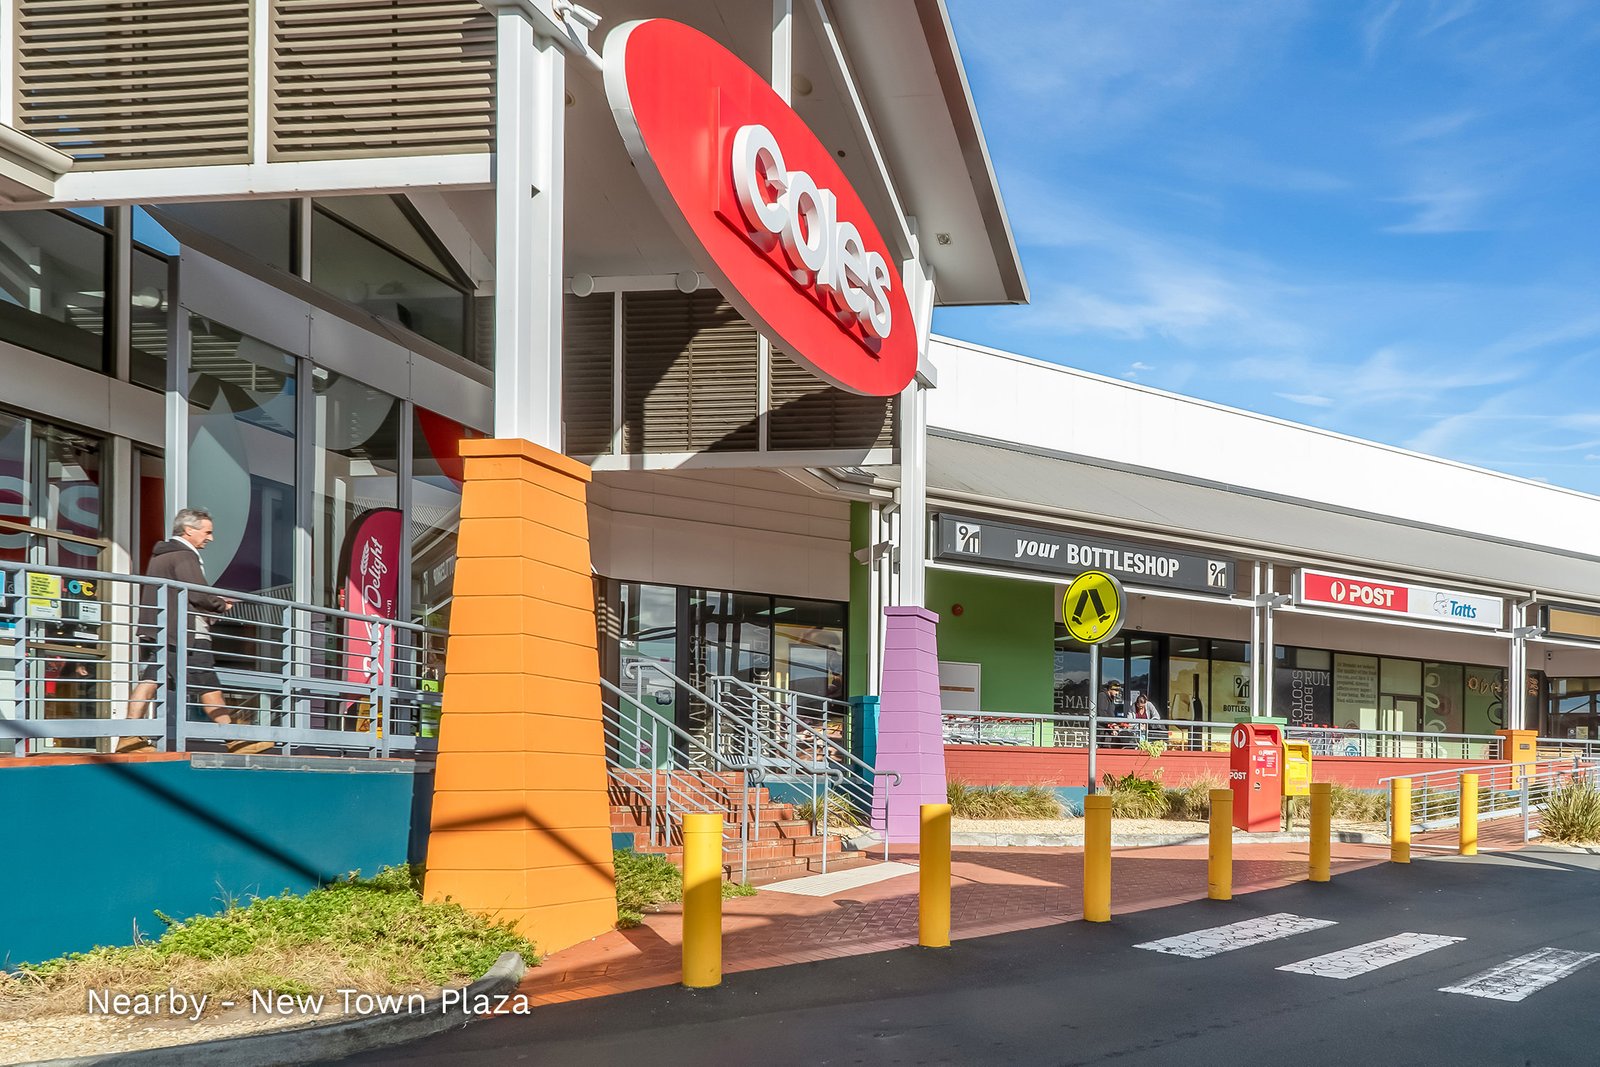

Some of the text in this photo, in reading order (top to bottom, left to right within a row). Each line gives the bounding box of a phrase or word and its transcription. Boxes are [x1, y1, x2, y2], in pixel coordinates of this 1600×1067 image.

[732, 124, 892, 339] Coles
[1015, 538, 1180, 577] your BOTTLESHOP
[364, 536, 388, 609] Delight
[1350, 584, 1395, 607] POST
[1450, 600, 1477, 619] Tatts
[1304, 671, 1330, 686] RUM
[1230, 772, 1247, 780] POST
